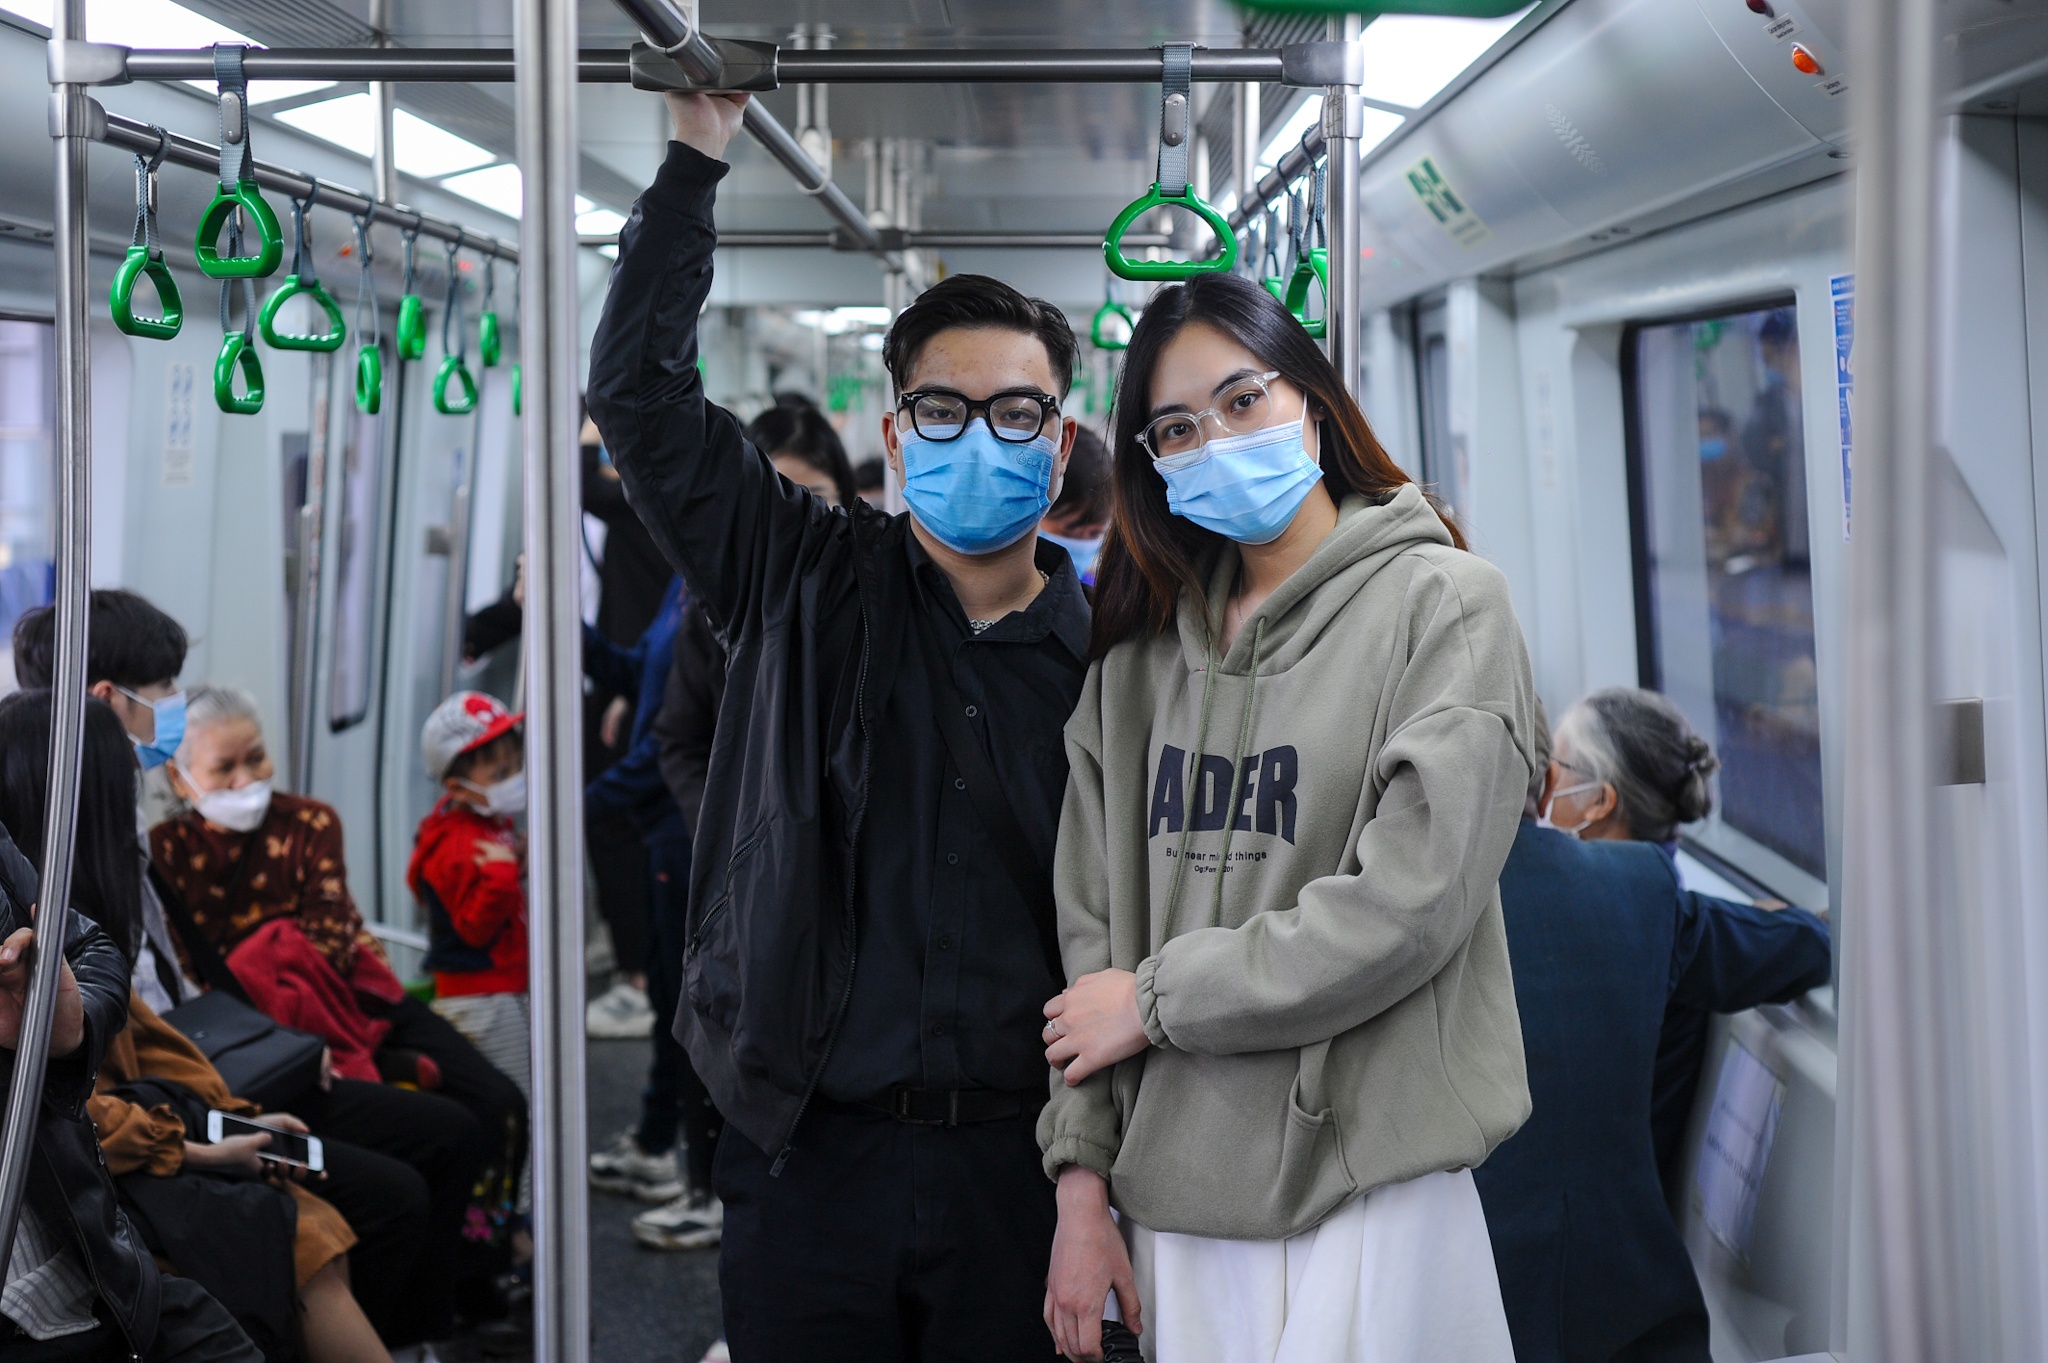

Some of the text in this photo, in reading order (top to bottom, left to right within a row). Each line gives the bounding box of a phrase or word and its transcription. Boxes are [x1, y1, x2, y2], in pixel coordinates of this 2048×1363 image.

[1149, 743, 1298, 846] ADER
[1166, 847, 1179, 858] Bu
[1184, 851, 1206, 860] near
[1235, 851, 1267, 862] things
